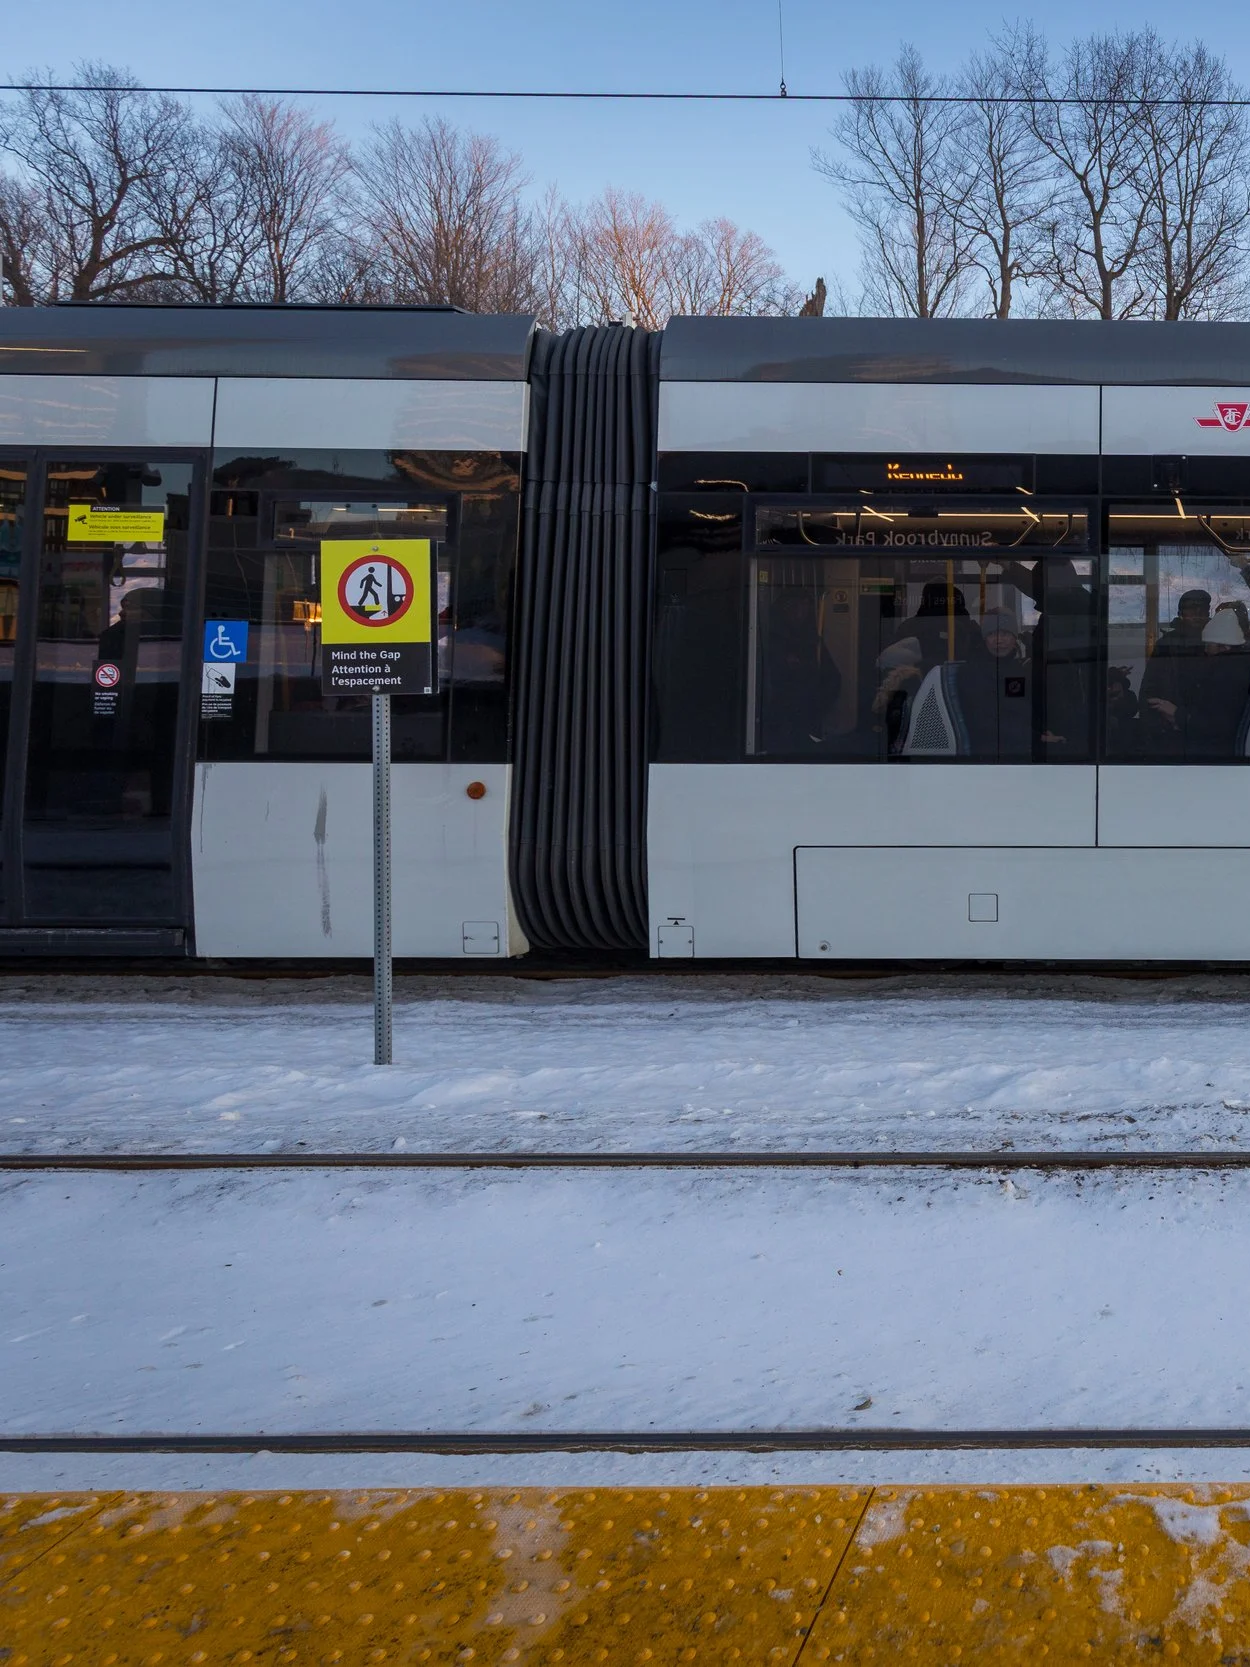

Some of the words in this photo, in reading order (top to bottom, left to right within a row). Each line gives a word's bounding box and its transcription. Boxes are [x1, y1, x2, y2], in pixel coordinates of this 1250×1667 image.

[331, 650, 357, 660] Mind
[360, 650, 377, 660] the
[379, 650, 401, 661] Gap
[331, 664, 382, 674] Attention
[384, 663, 391, 673] à
[331, 676, 402, 687] l'espacement
